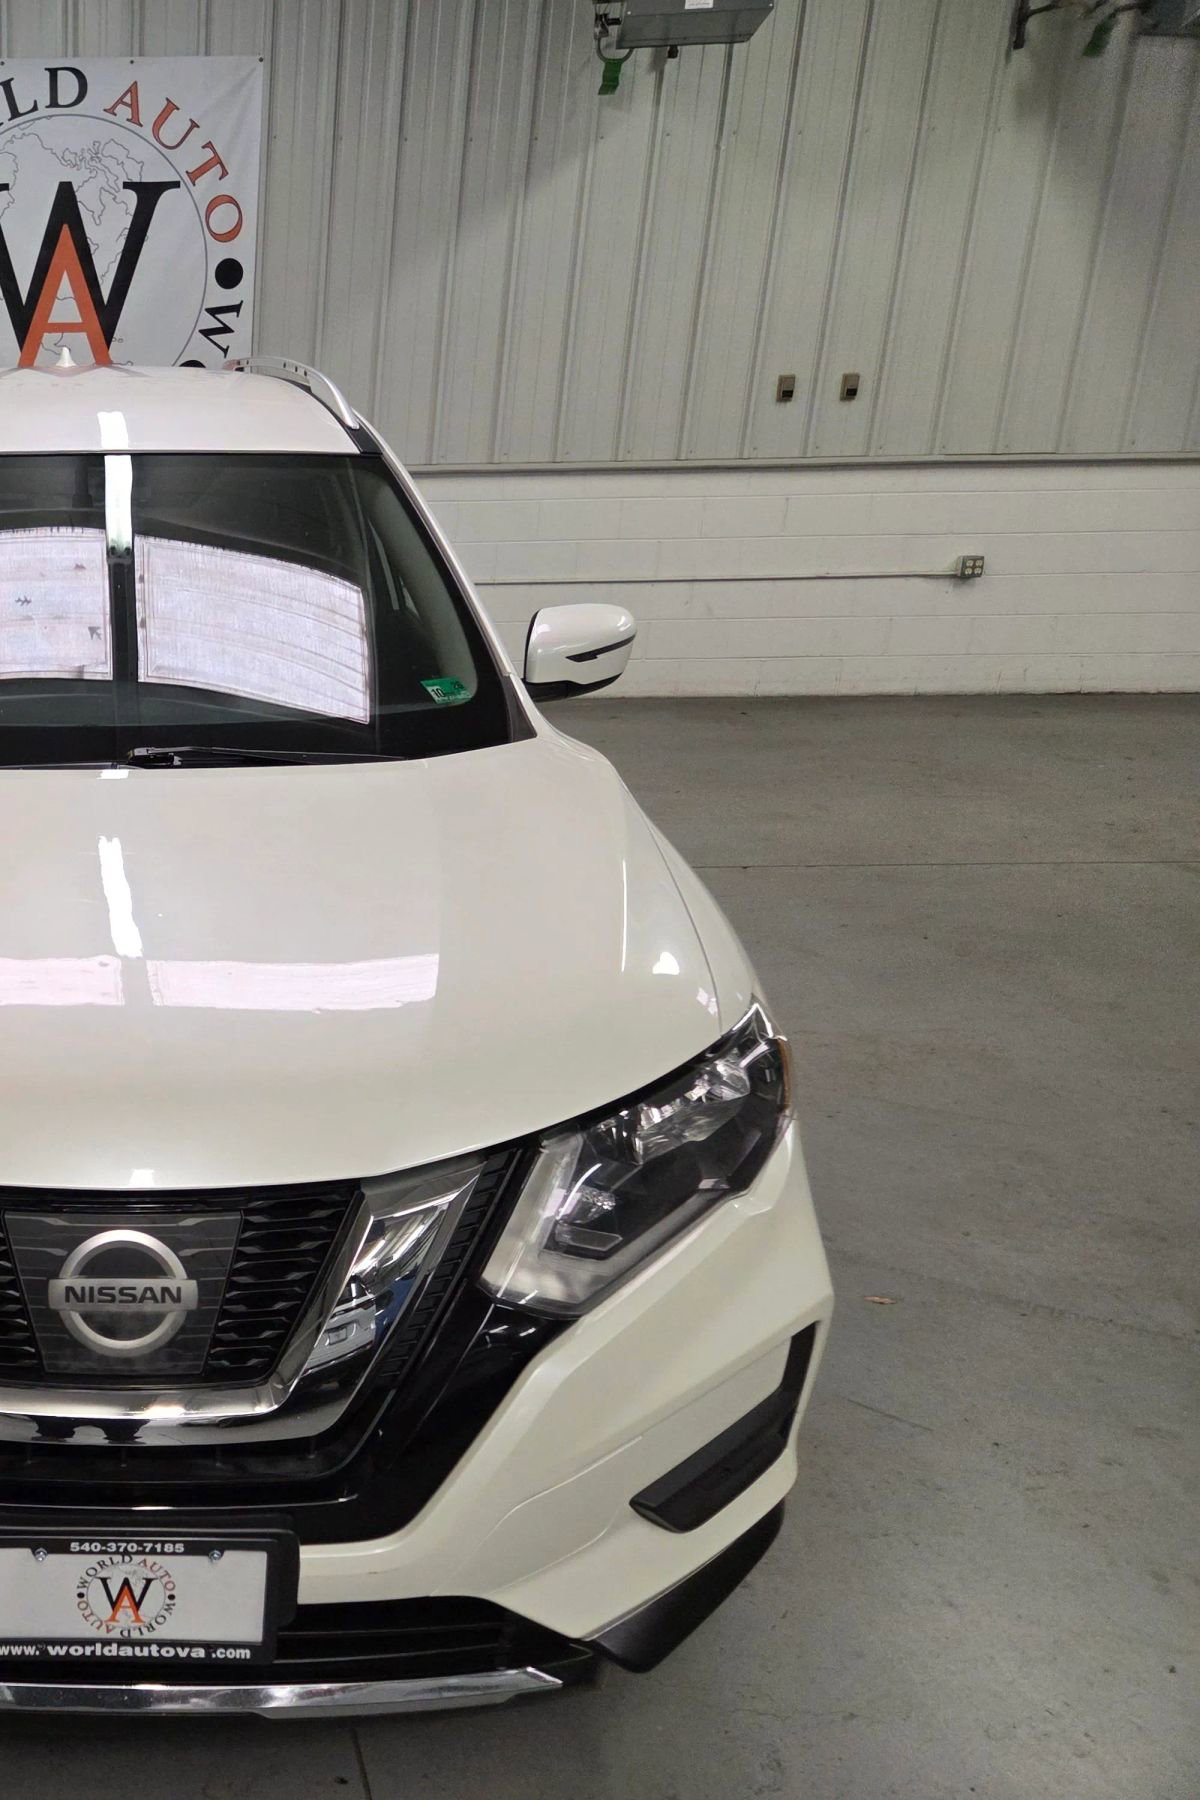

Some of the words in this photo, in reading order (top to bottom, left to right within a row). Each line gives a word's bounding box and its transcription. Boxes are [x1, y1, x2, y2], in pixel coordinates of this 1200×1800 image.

[103, 80, 243, 242] AUTO
[65, 1286, 182, 1304] NISSAN
[70, 1542, 185, 1553] 540-370-7185
[77, 1554, 133, 1590] WORLD
[138, 1558, 176, 1592] AUTO
[77, 1600, 116, 1634] AUTO
[120, 1602, 176, 1639] WORLD
[47, 1642, 206, 1658] worldautova
[211, 1647, 251, 1660] .com
